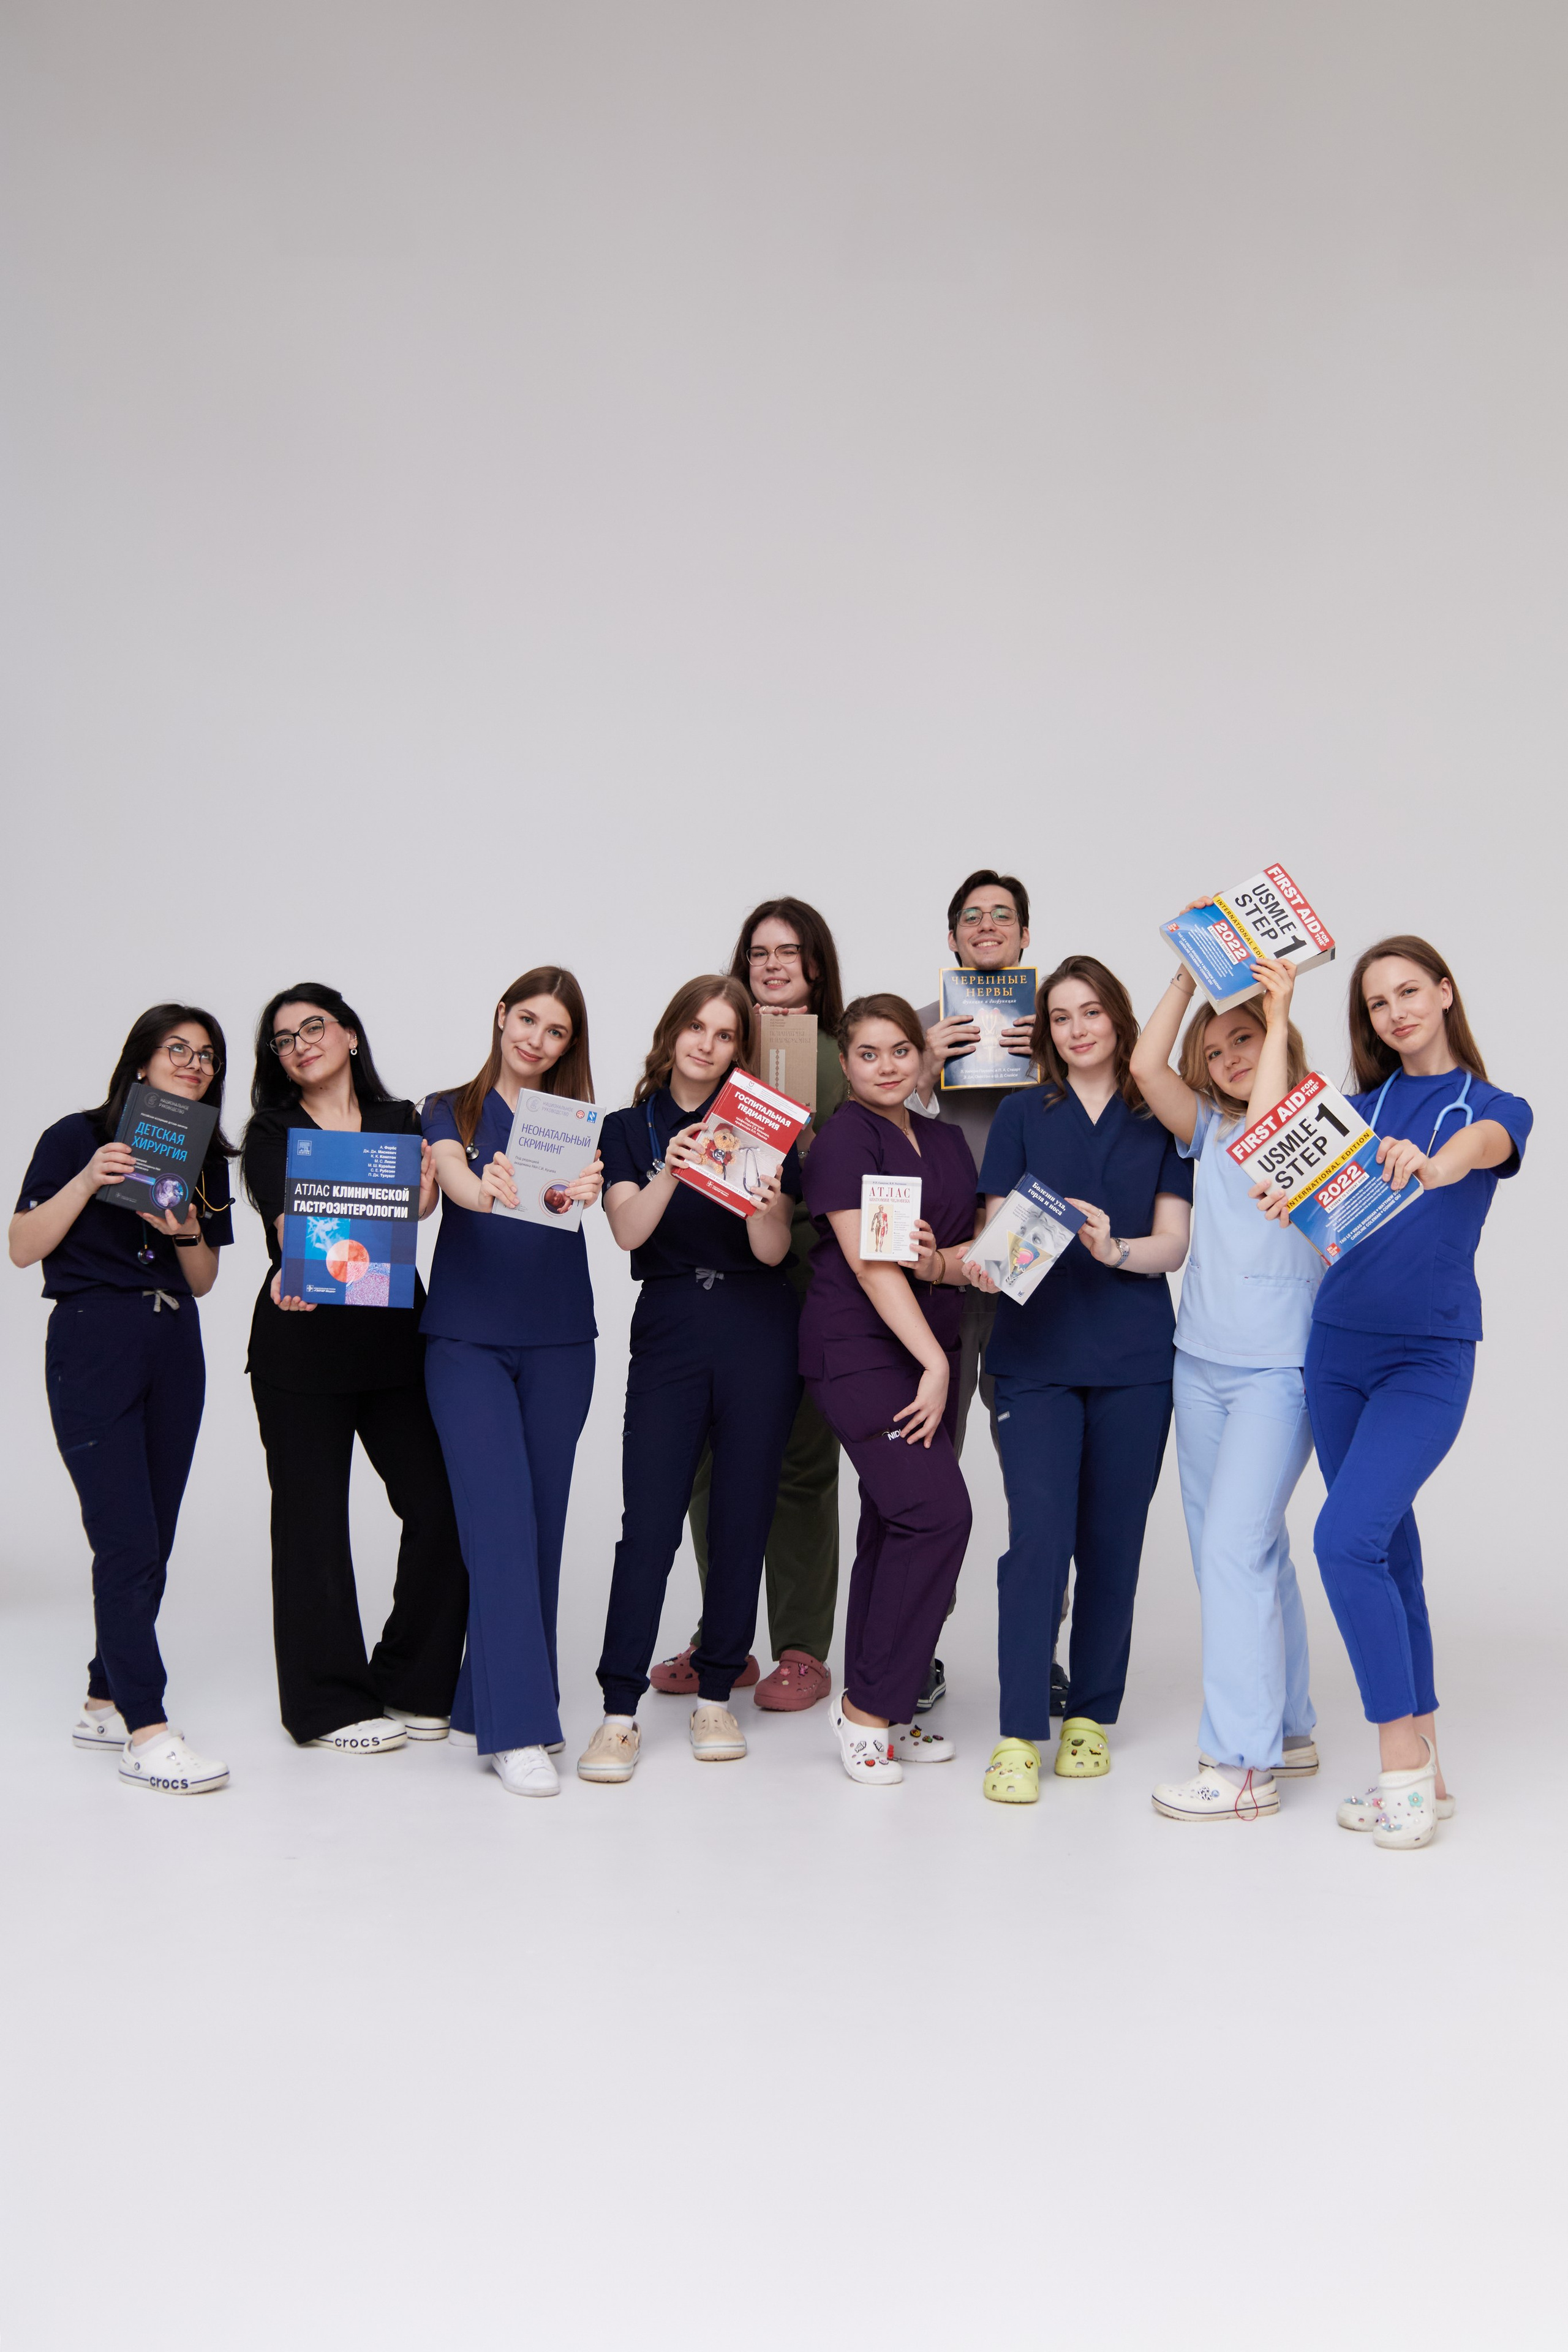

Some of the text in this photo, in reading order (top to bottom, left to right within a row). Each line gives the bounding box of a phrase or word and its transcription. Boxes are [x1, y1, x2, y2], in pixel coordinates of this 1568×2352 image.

[1267, 866, 1321, 933] FIRST AID
[1216, 899, 1253, 946] INTERNATIONAL
[1235, 894, 1278, 940] STEP
[1273, 935, 1307, 959] 1
[1215, 922, 1247, 960] 2022
[1319, 931, 1330, 943] FOR
[952, 975, 1028, 985] ЧЕРЕПНЫЕ
[966, 987, 1013, 997] НЕРВЫ
[1300, 1079, 1315, 1093] FOR
[541, 1106, 570, 1117] РУКОВОДСТВО
[543, 1101, 573, 1112] НАЦИОНАЛЬНОЕ
[734, 1091, 791, 1128] ГОСПИТАЛЬНАЯ
[737, 1103, 780, 1131] ПЕДИАТРИЯ
[135, 1121, 186, 1145] ДЕТСКАЯ
[522, 1123, 591, 1148] НЕОНАТАЛЬНЫЙ
[1231, 1091, 1306, 1161] FIRST AID
[131, 1136, 188, 1162] ХИРУРГИЯ
[518, 1137, 565, 1155] СКРИНИНГ
[1275, 1102, 1350, 1189] STEP 1
[1286, 1133, 1370, 1209] INTERNATIONAL EDITION
[294, 1183, 410, 1202] АТЛАС КЛИНИЧЕСКОЙ
[869, 1186, 910, 1198] АТЛАС
[1032, 1182, 1066, 1212] Болезни уха,
[1318, 1165, 1362, 1205] 2022
[1330, 1183, 1359, 1208] STUDENT-TO-STUDENT
[1358, 1175, 1367, 1185] GUIDE
[293, 1200, 409, 1218] ГАСТРОЭНТЕРОЛОГИИ
[1028, 1188, 1044, 1202] горла
[1049, 1204, 1063, 1216] носа
[1351, 1223, 1362, 1233] VIKAS
[1377, 1194, 1395, 1210] MATTHEW
[1349, 1225, 1366, 1240] CAROLINE
[1365, 1212, 1382, 1227] COLEMAN
[1381, 1199, 1396, 1212] CONNIE
[335, 1737, 380, 1748] crocs
[149, 1776, 189, 1790] crocs
